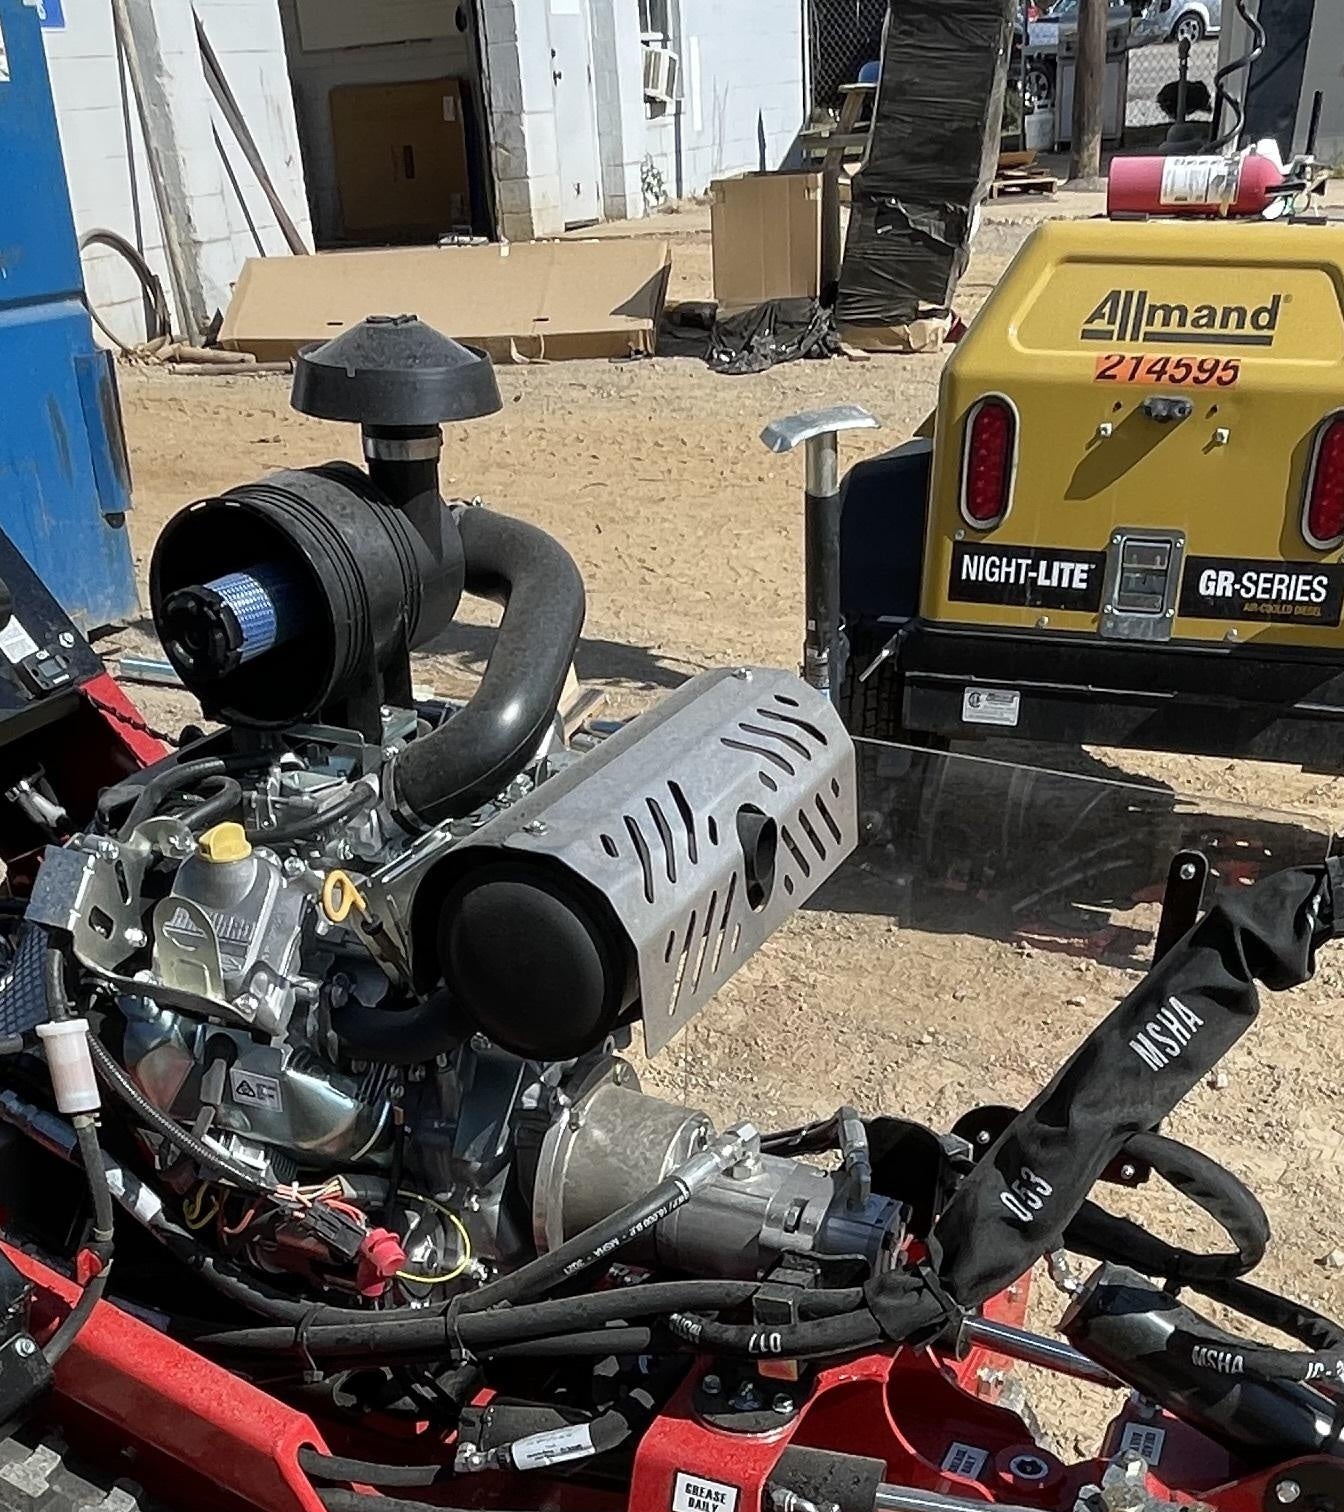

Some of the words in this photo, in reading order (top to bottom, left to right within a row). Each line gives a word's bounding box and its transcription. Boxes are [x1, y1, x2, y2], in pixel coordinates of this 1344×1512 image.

[1082, 290, 1282, 342] Allmand
[1096, 354, 1241, 386] 214595
[961, 553, 1091, 589] NIGHT-LITE
[1199, 568, 1329, 603] GR-SERIES
[1129, 996, 1205, 1071] MSHA
[999, 1166, 1053, 1222] 053
[1192, 1345, 1245, 1374] MSHA
[685, 1483, 727, 1505] GREASE
